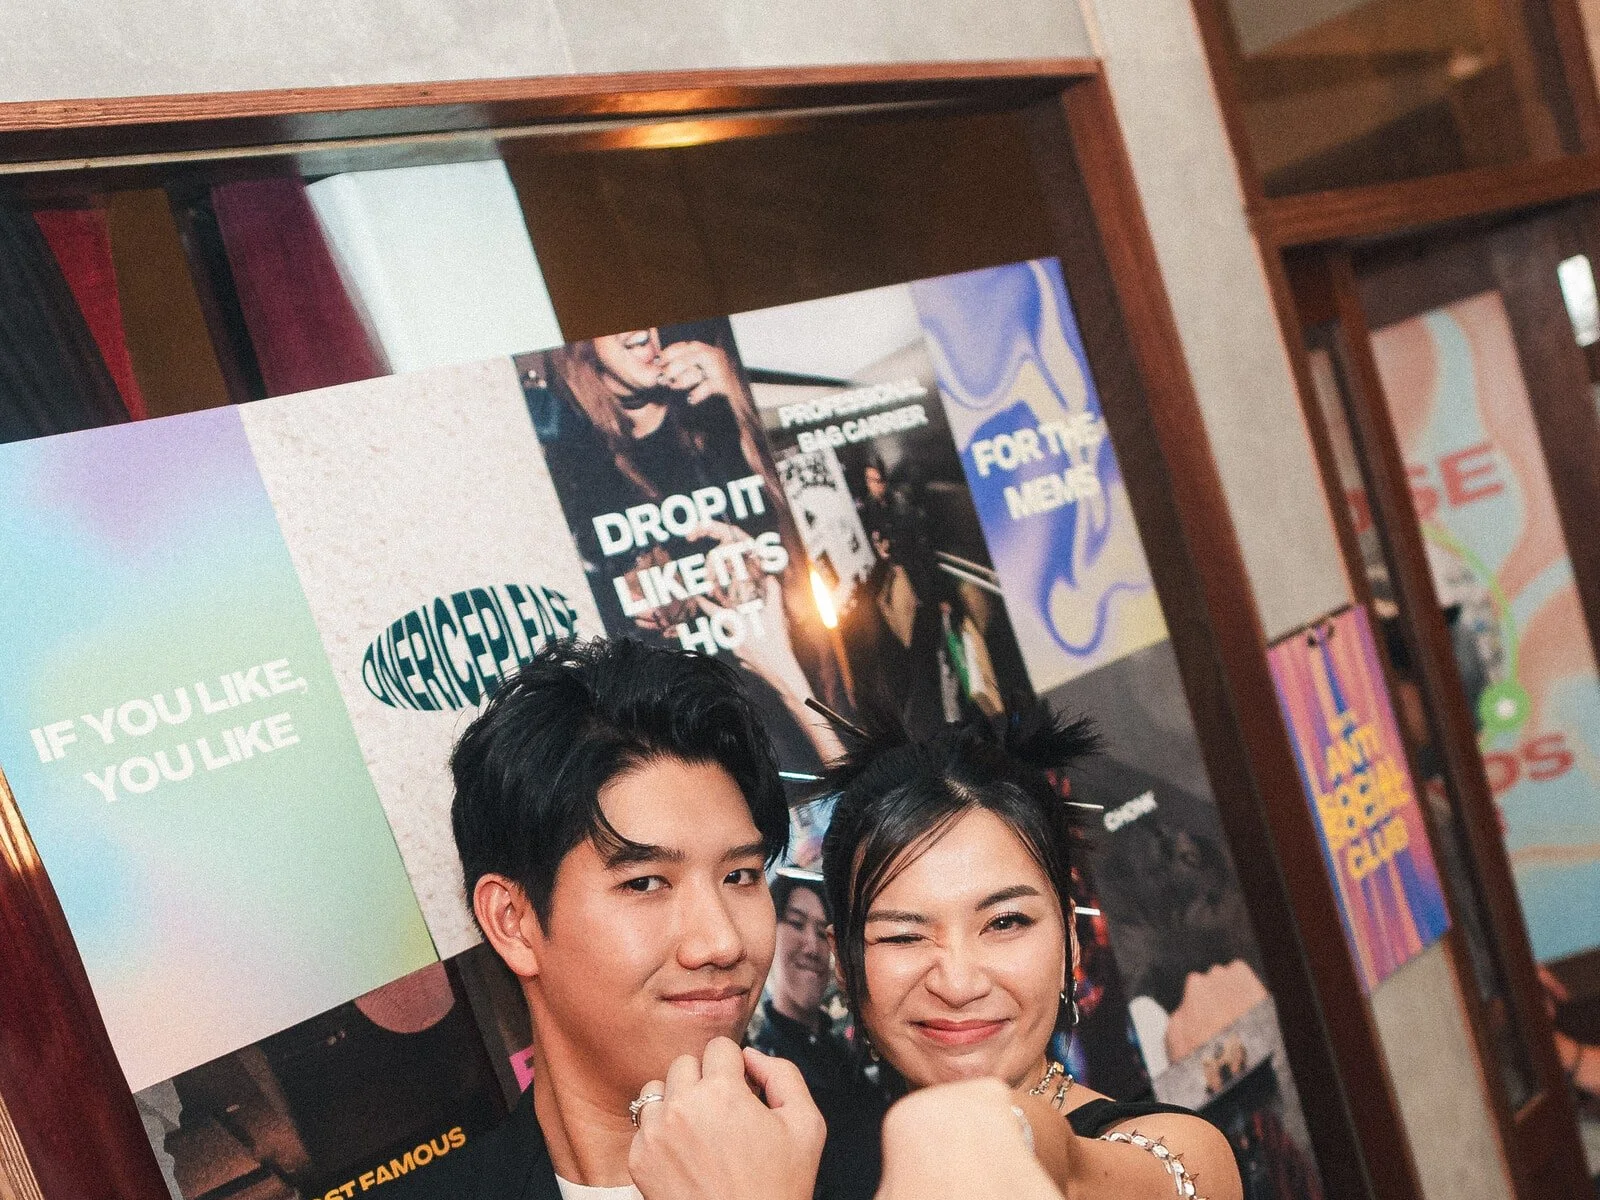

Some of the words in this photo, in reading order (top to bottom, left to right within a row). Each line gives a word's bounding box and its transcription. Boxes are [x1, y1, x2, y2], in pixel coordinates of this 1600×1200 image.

[797, 425, 847, 453] BAG
[842, 404, 929, 443] CARRIER
[972, 428, 1044, 478] FOR
[1039, 412, 1106, 456] THE
[592, 486, 727, 557] DROP
[726, 474, 766, 520] IT
[612, 552, 714, 617] LIKE
[706, 531, 789, 588] IT'S
[676, 598, 765, 656] HOT
[29, 719, 78, 764] IF
[81, 687, 192, 745] YOU
[193, 657, 309, 716] LIKE,
[82, 743, 195, 803] YOU
[196, 711, 300, 771] LIKE
[1326, 722, 1381, 782] ANTI
[1347, 815, 1409, 880] CLUB
[358, 1126, 467, 1191] FAMOUS
